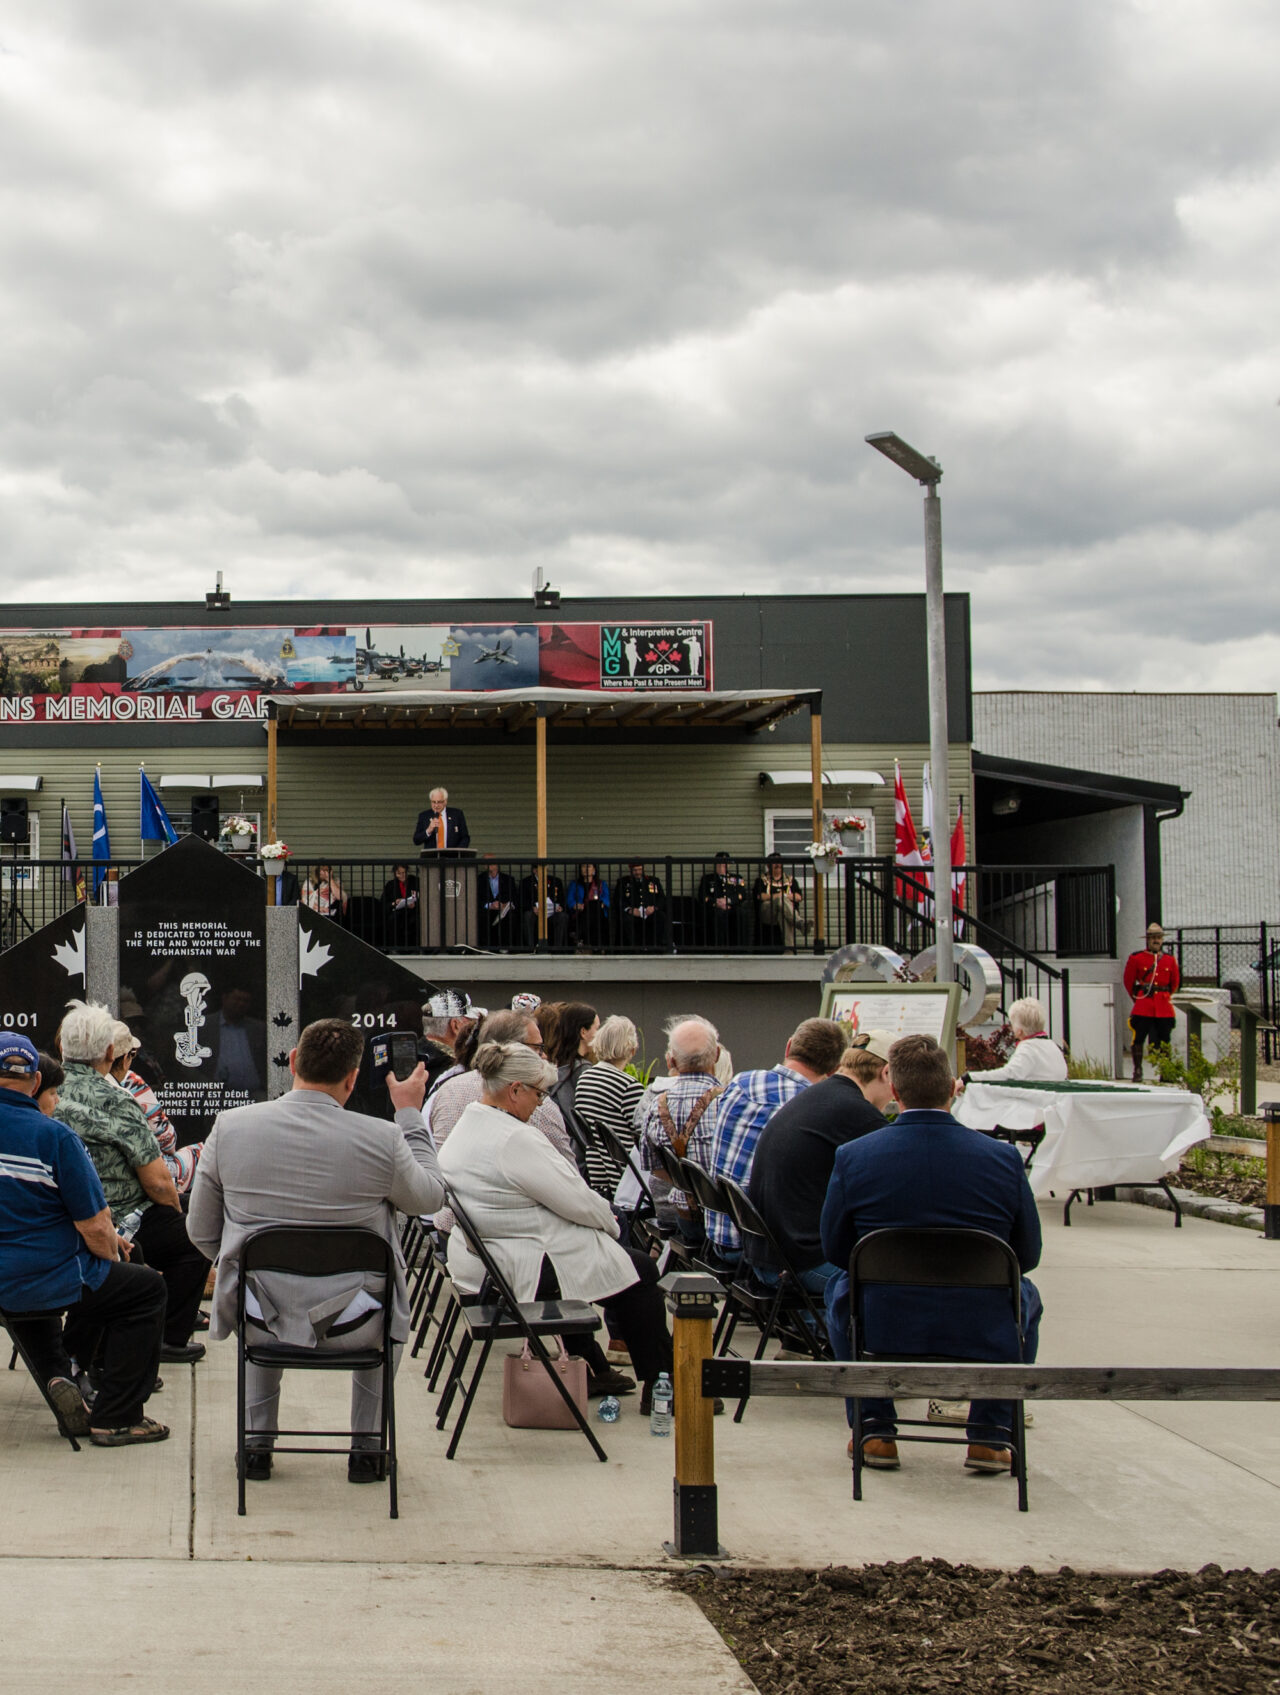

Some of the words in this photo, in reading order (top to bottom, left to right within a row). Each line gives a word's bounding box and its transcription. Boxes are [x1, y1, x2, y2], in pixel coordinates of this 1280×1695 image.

[621, 628, 628, 637] &
[630, 628, 675, 638] Interpretive
[676, 628, 702, 637] Centre
[656, 664, 672, 674] GP
[603, 679, 623, 687] Where
[623, 679, 633, 687] the
[634, 679, 647, 687] Past
[688, 678, 703, 686] Meet
[46, 695, 202, 720] MEMORIAL
[211, 694, 269, 719] GAR
[159, 922, 178, 930] THIS
[182, 922, 228, 930] MEMORIAL
[151, 948, 212, 956] AFGHANISTAN
[216, 948, 236, 956] WAR
[351, 1013, 397, 1028] 2014
[0, 1047, 19, 1056] NATIVE
[225, 1089, 249, 1098] DÉDIÉ
[190, 1108, 200, 1116] EN
